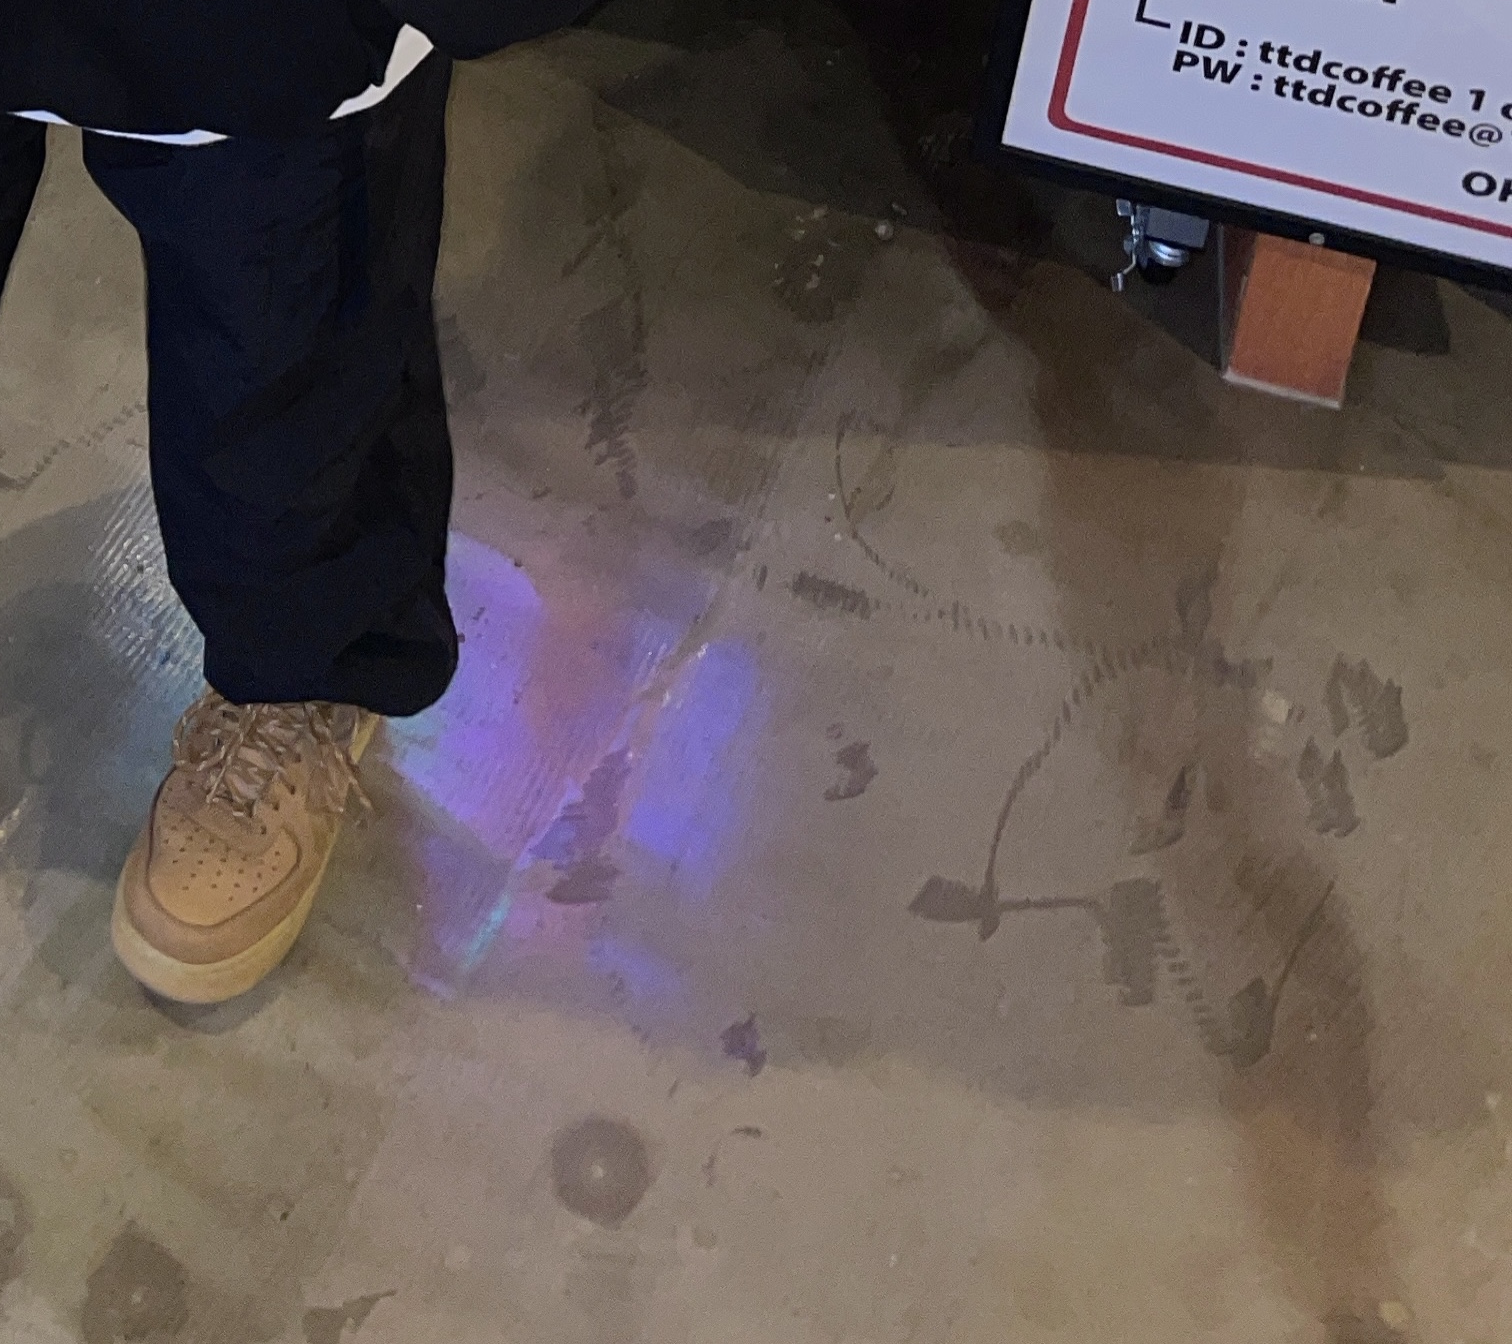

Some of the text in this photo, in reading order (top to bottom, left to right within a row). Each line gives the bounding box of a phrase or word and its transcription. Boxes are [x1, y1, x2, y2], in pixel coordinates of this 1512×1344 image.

[1171, 49, 1243, 84] PW
[1273, 75, 1512, 148] ttdcoffee@
[1178, 20, 1226, 51] ID
[1258, 40, 1453, 105] ttdcoffee
[1468, 88, 1486, 112] 1
